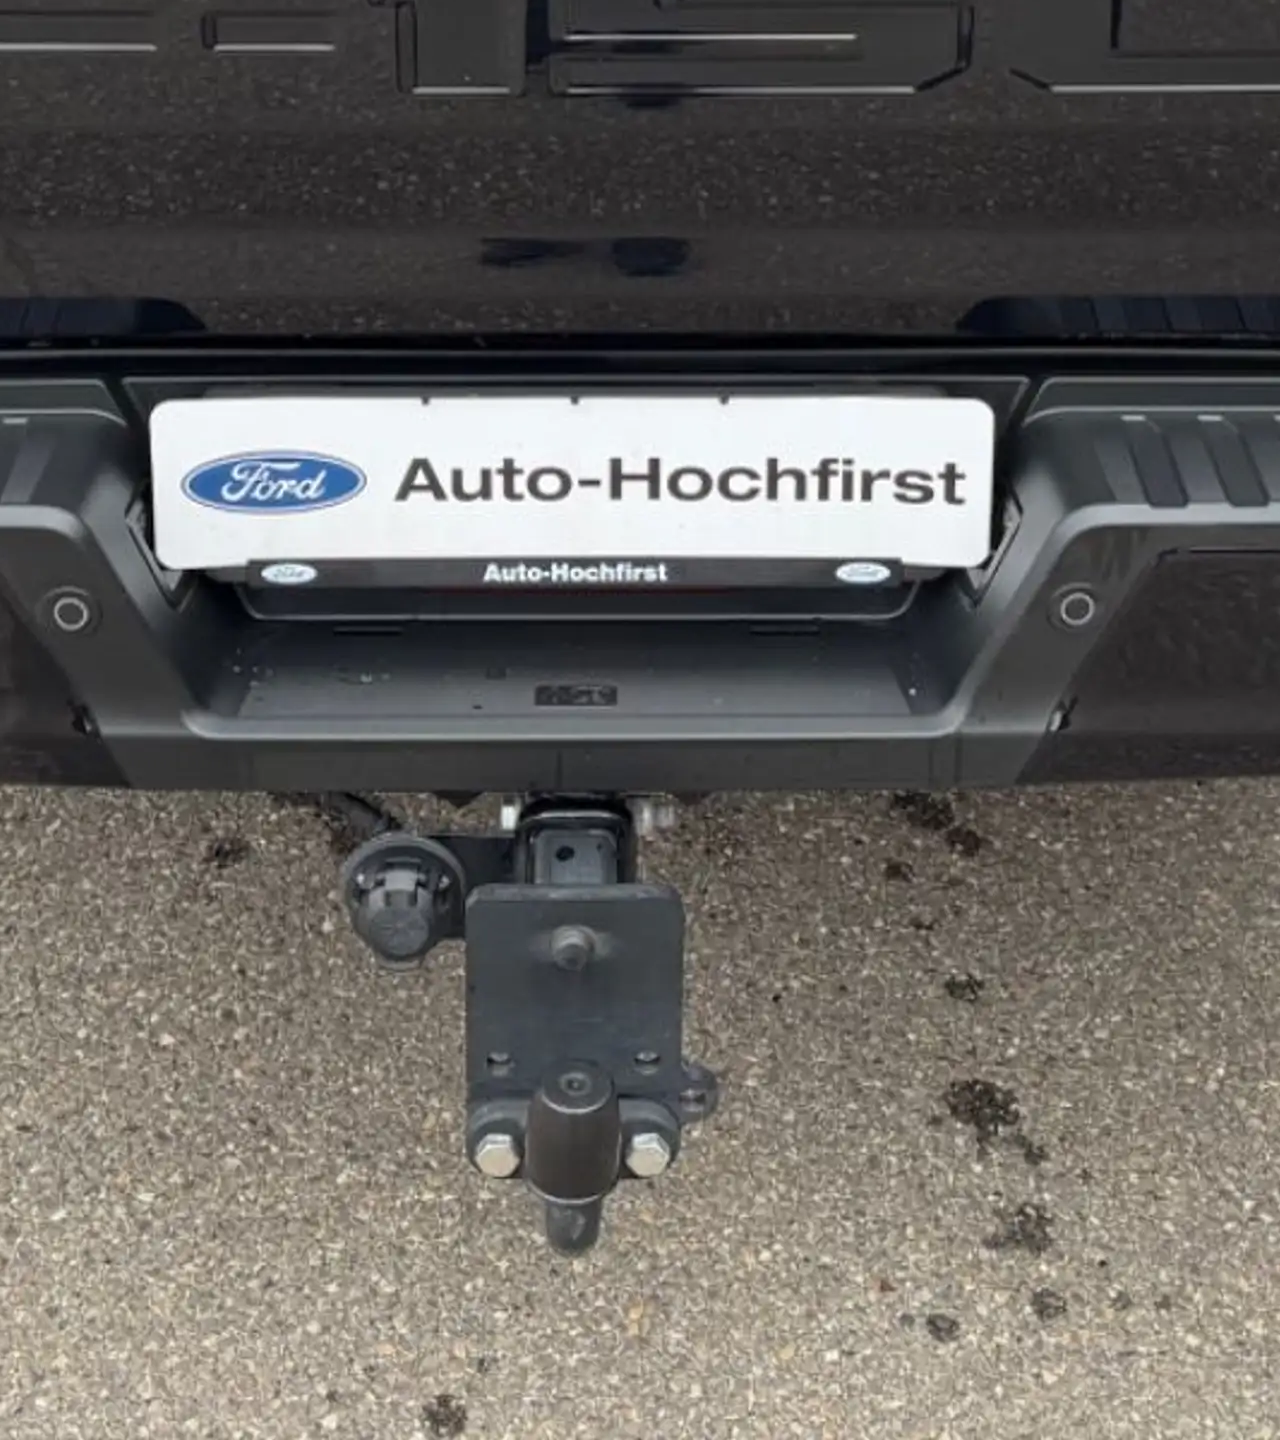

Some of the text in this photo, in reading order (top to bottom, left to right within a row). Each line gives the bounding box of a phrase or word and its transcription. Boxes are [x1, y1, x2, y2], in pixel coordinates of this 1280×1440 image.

[221, 457, 967, 506] Ford Auto-Hochfirst
[482, 562, 669, 584] Auto-Hochfirst
